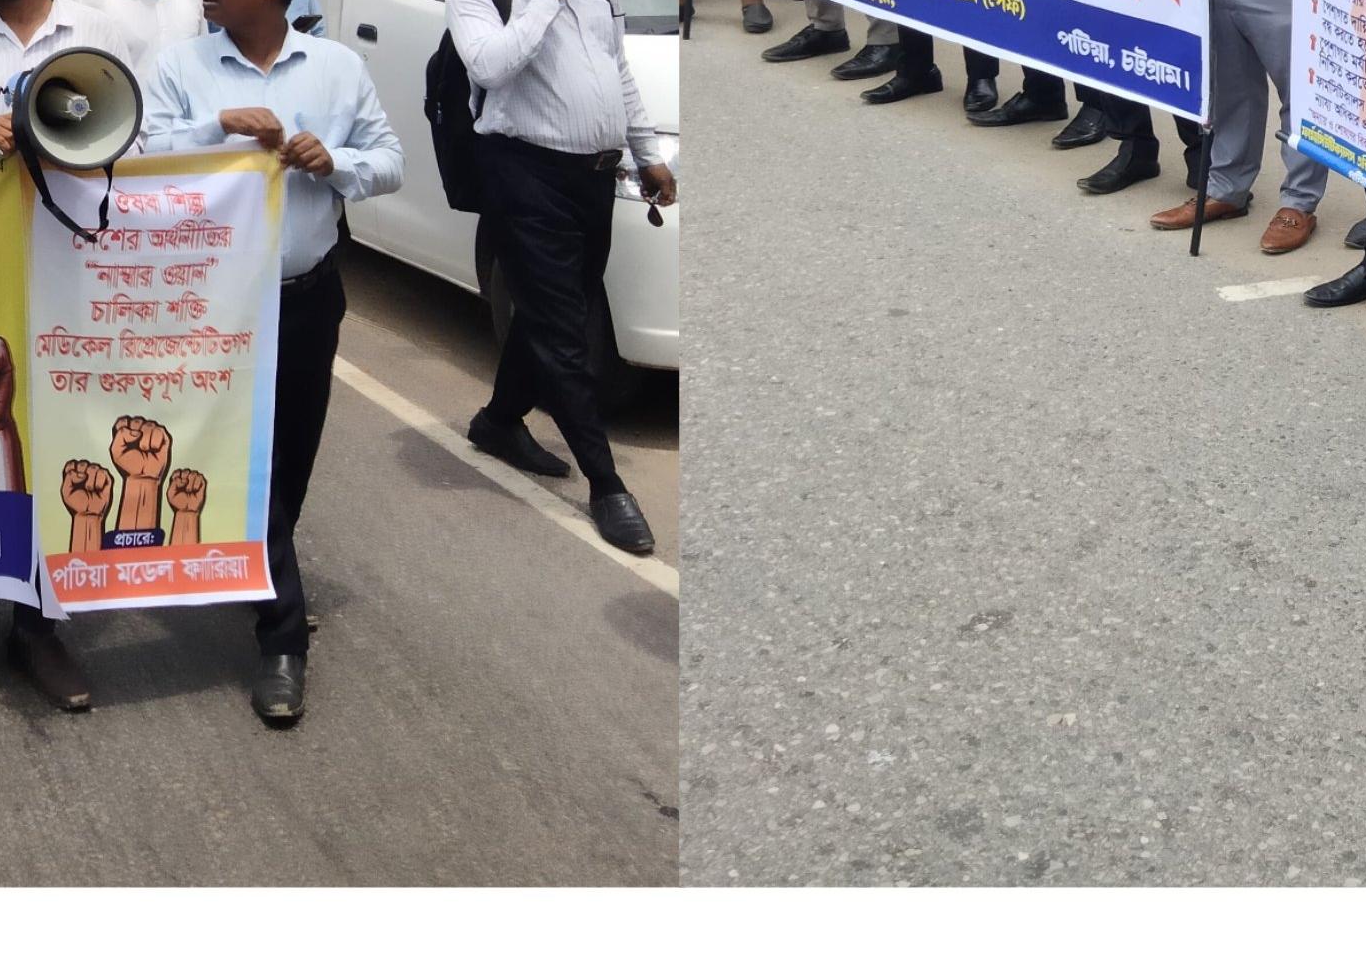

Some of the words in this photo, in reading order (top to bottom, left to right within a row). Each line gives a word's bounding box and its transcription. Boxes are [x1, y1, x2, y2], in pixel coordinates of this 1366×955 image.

[1057, 28, 1115, 68] পটিয়া,
[113, 186, 161, 215] ঔষধ
[164, 185, 208, 217] শিল্প
[148, 219, 235, 251] অর্থনীতির
[90, 293, 160, 325] চালিকা
[165, 291, 210, 323] শক্তি
[36, 325, 114, 359] মেডিকেল
[119, 325, 254, 361] রিপ্রেজেন্টেটিভগণ
[49, 369, 92, 395] তার
[98, 364, 188, 403] গুরুত্বপূর্ণ
[190, 368, 235, 395] অংশ
[113, 531, 156, 546] প্রচারে:
[52, 557, 110, 592] পটিয়া
[115, 559, 176, 586] মডেল
[181, 548, 250, 582] ফারিয়া
